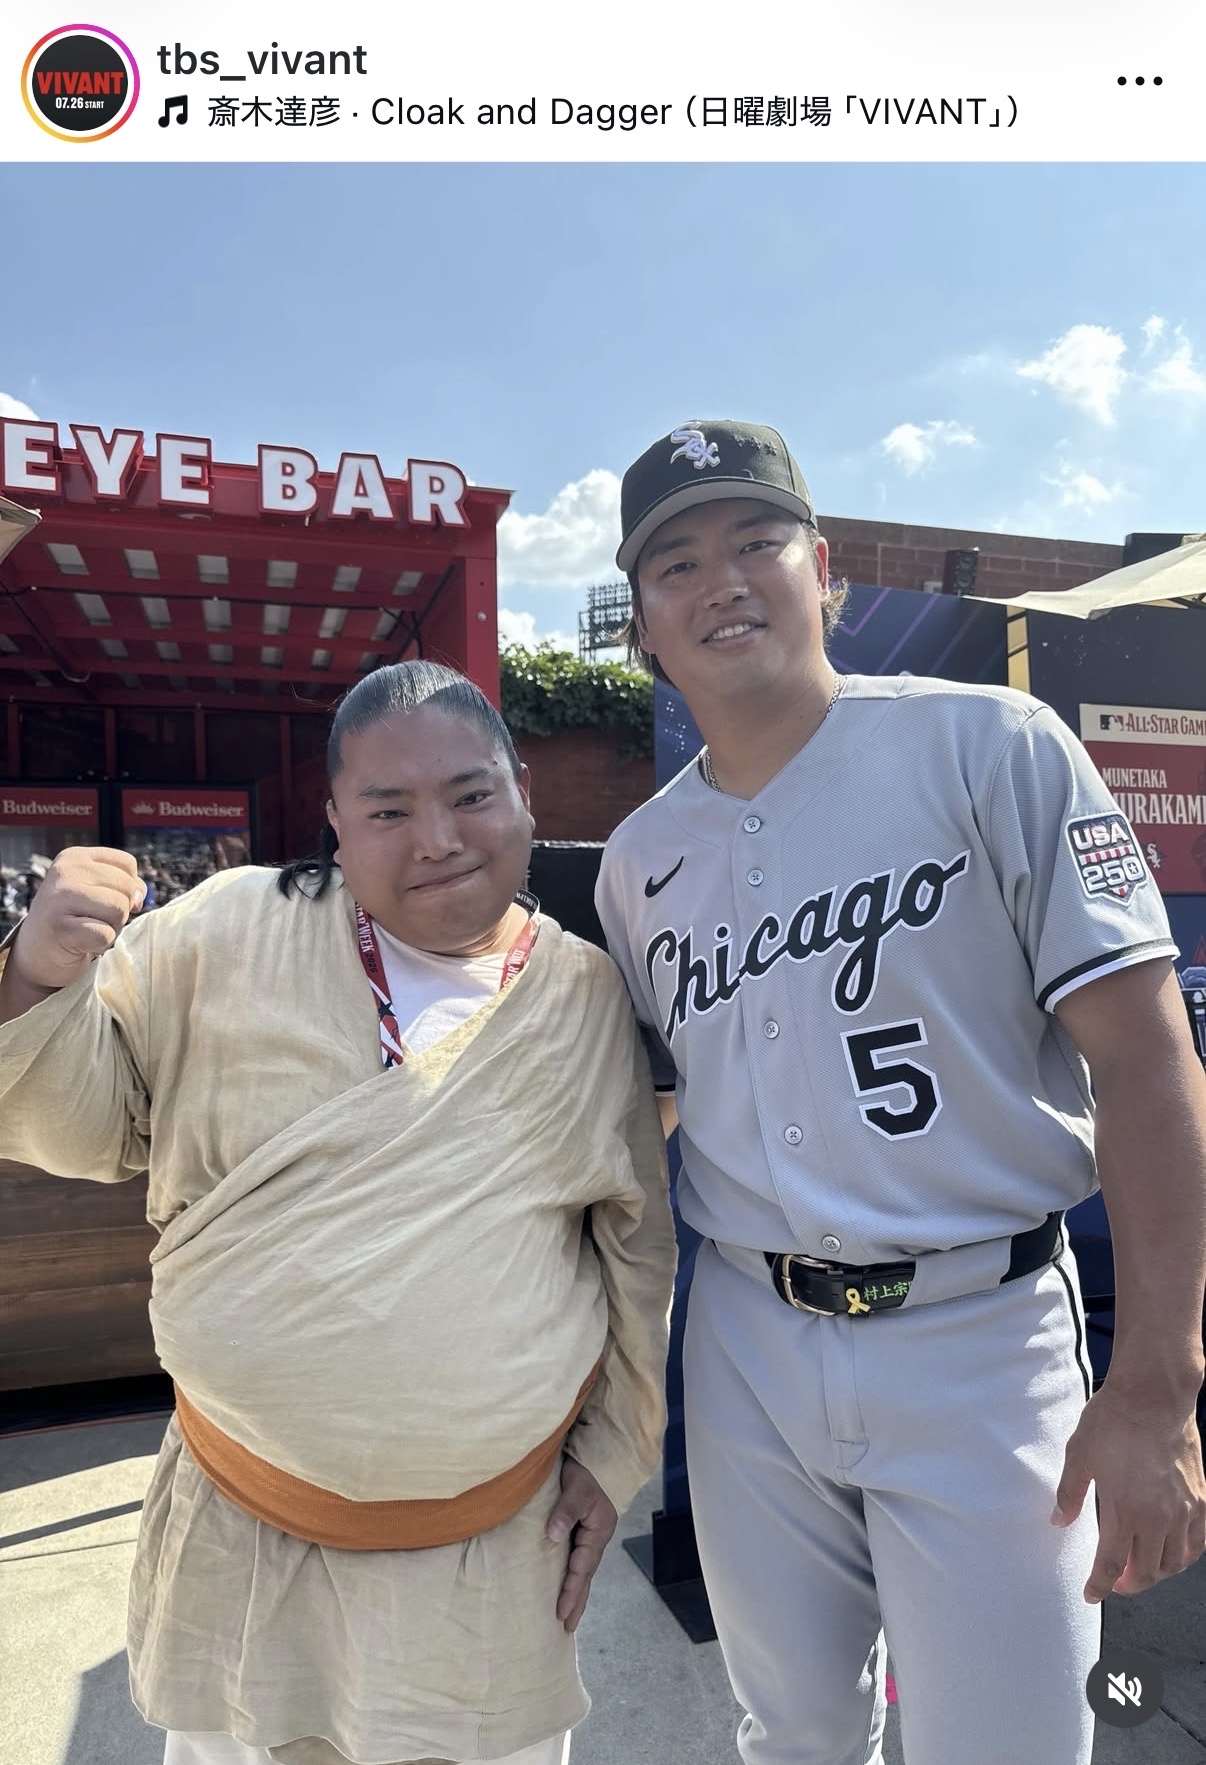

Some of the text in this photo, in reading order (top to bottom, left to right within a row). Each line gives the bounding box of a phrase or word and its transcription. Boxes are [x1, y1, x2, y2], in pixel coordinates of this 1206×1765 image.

[257, 444, 471, 528] BAR
[1180, 715, 1206, 736] GAM
[1101, 767, 1167, 789] MUNETAKA
[3, 800, 93, 816] Budweiser
[158, 801, 244, 818] Budweiser
[1072, 823, 1129, 850] USA
[1082, 857, 1142, 892] 250
[646, 849, 971, 1048] Chicago
[840, 1017, 943, 1141] 5
[863, 1281, 911, 1301] 村上宗
